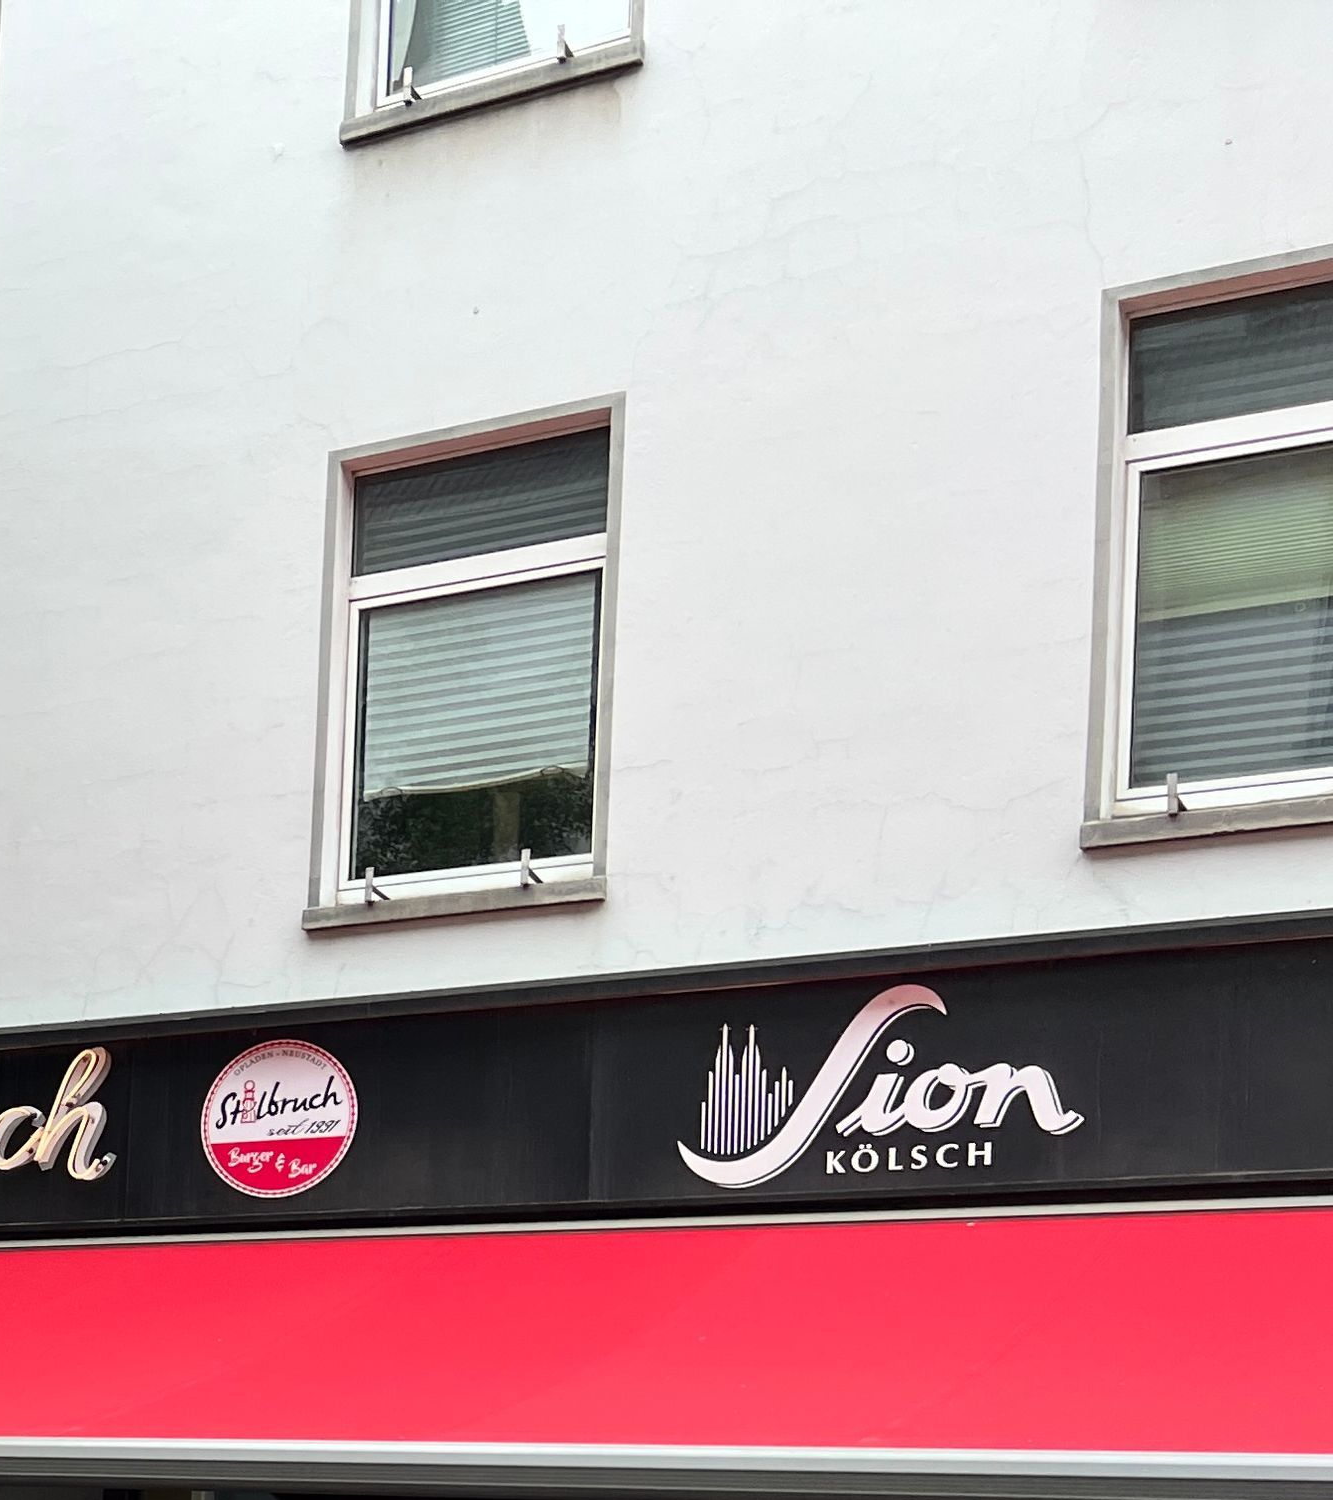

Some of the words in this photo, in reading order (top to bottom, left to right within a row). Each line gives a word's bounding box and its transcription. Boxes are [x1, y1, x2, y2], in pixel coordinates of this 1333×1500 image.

[234, 1050, 275, 1076] OPLADEN
[282, 1049, 327, 1071] NEUSTADT
[677, 983, 1085, 1189] Sion
[266, 1117, 310, 1137] seit
[227, 1147, 275, 1174] Burger
[288, 1158, 318, 1179] Bar
[825, 1141, 994, 1175] KÖLSCH
